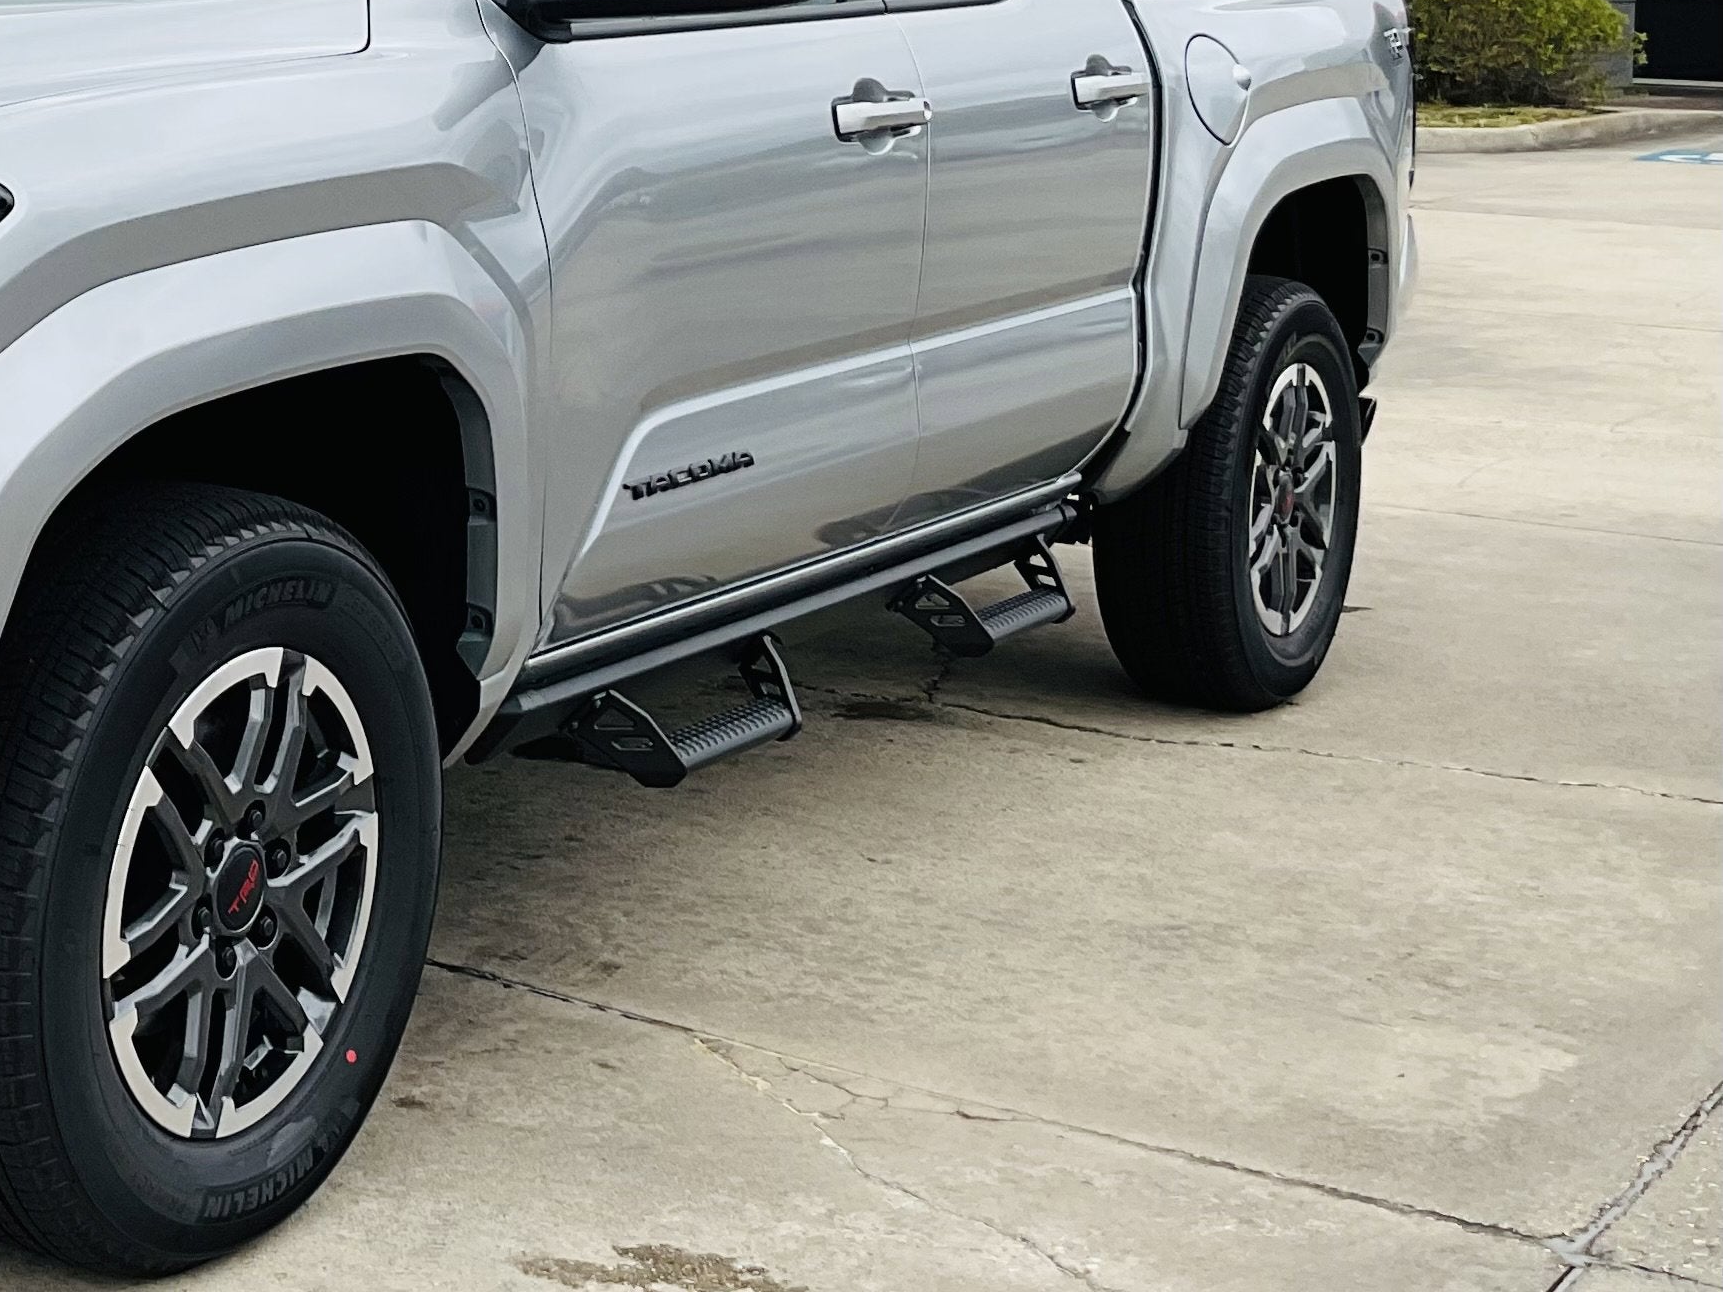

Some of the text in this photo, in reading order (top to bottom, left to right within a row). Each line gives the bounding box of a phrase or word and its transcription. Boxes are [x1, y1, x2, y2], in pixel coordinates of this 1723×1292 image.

[622, 451, 756, 501] TACOMA
[224, 579, 333, 628] MICHELIN
[227, 858, 259, 915] TRD
[204, 1145, 315, 1219] MICHELIN
